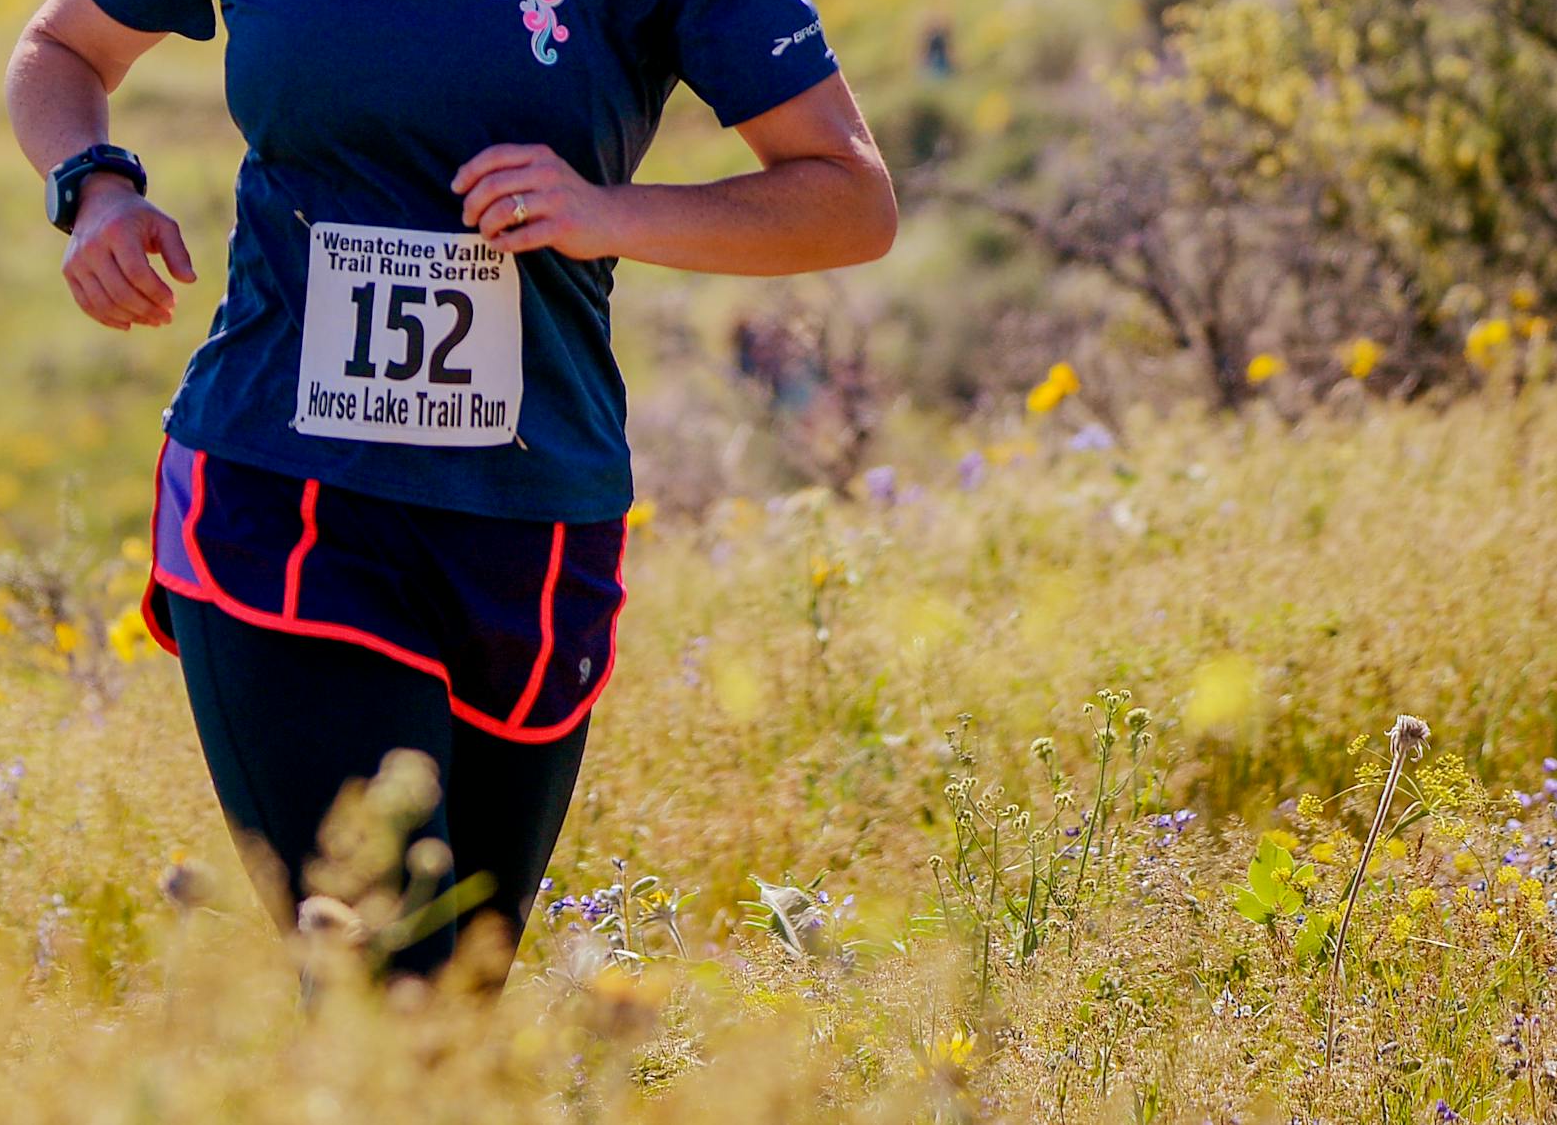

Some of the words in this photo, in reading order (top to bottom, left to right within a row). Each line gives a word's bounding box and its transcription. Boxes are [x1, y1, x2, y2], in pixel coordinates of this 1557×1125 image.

[323, 231, 436, 259] Wenatchee
[328, 252, 372, 274] Trail
[380, 257, 421, 278] Run
[429, 262, 501, 281] Series
[344, 282, 474, 384] 152
[308, 381, 357, 421] Horse
[362, 386, 409, 425] Lake
[416, 391, 463, 428] Trail
[470, 393, 507, 428] Run
